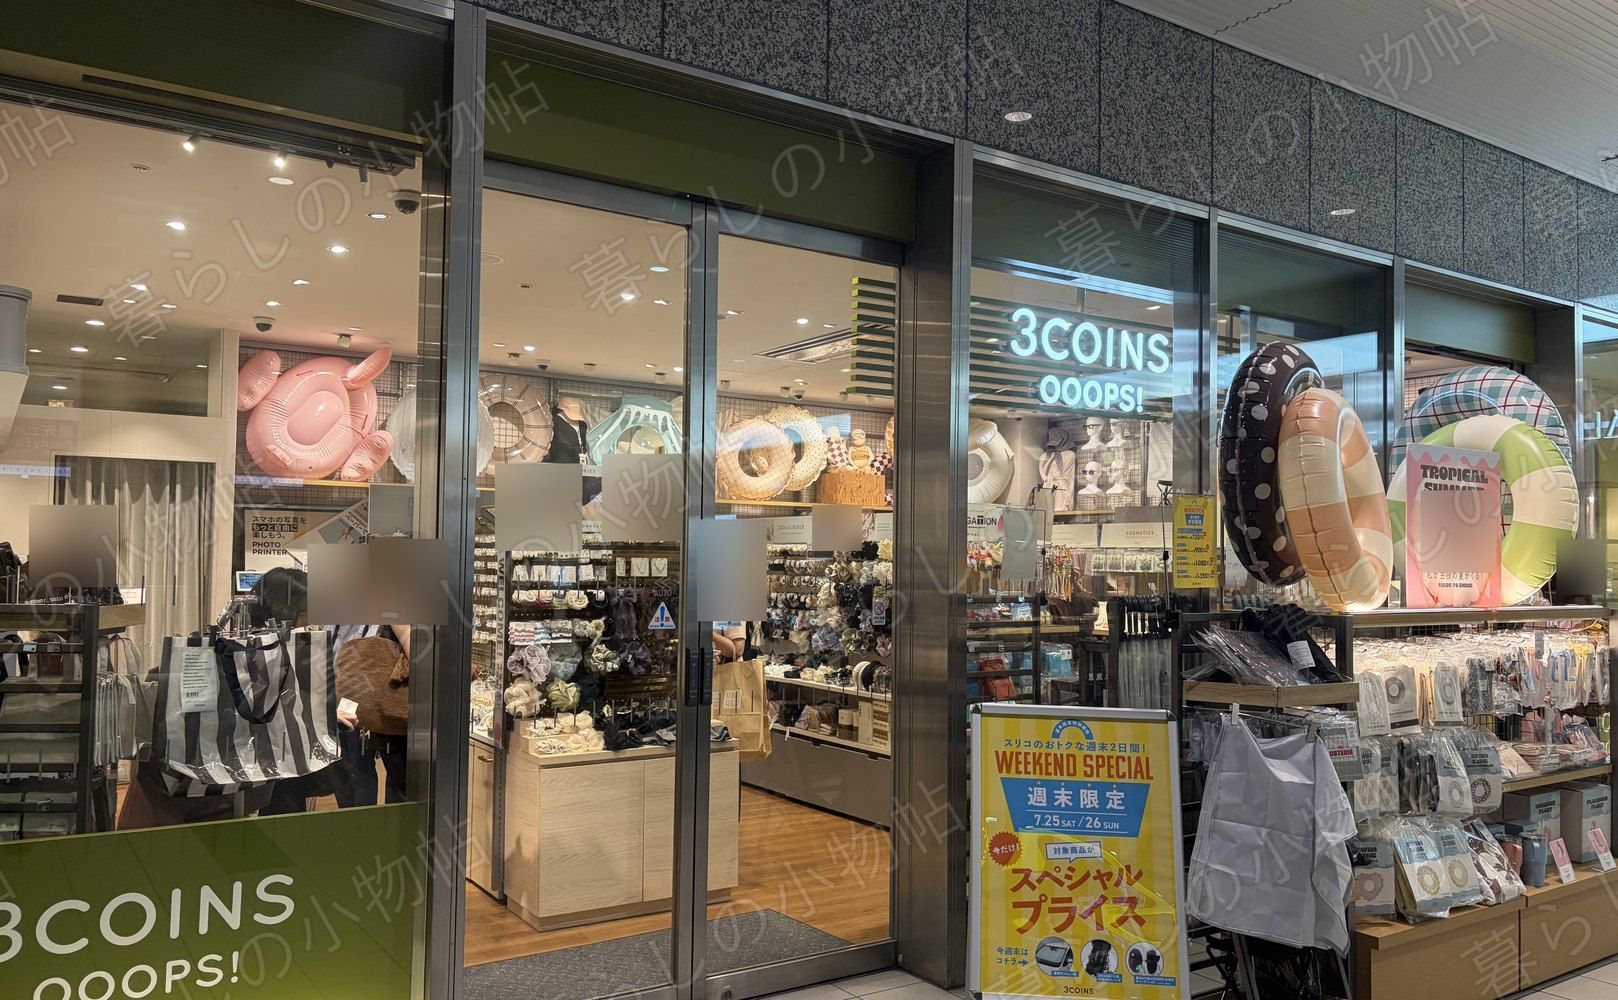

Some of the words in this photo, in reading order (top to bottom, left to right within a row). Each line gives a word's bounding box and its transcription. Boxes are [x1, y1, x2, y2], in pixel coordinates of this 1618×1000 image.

[1010, 308, 1169, 374] 3COINS
[1040, 375, 1143, 413] OOOPS!
[1420, 464, 1488, 484] TROPICAL
[252, 516, 307, 524] スマホの写真を
[252, 524, 298, 532] もっと自由に
[653, 589, 673, 597] AUTO
[1004, 738, 1146, 754] スリコのおトクな週末2日間!
[995, 750, 1077, 777] WEEKEND
[1083, 754, 1154, 780] SPECIAL
[1027, 786, 1126, 810] 週末限定
[1034, 814, 1060, 827] 7.25
[1061, 819, 1076, 828] SAT
[1085, 816, 1101, 829] 26
[1103, 822, 1120, 830] SUN
[993, 844, 1020, 856] 今だけ!
[1053, 845, 1095, 855] 対象商品が
[1010, 864, 1144, 894] スペシャル
[1012, 893, 1146, 935] プライス
[996, 946, 1028, 956] 今週末は
[996, 957, 1017, 966] コチラ
[1063, 986, 1094, 995] 3COINS
